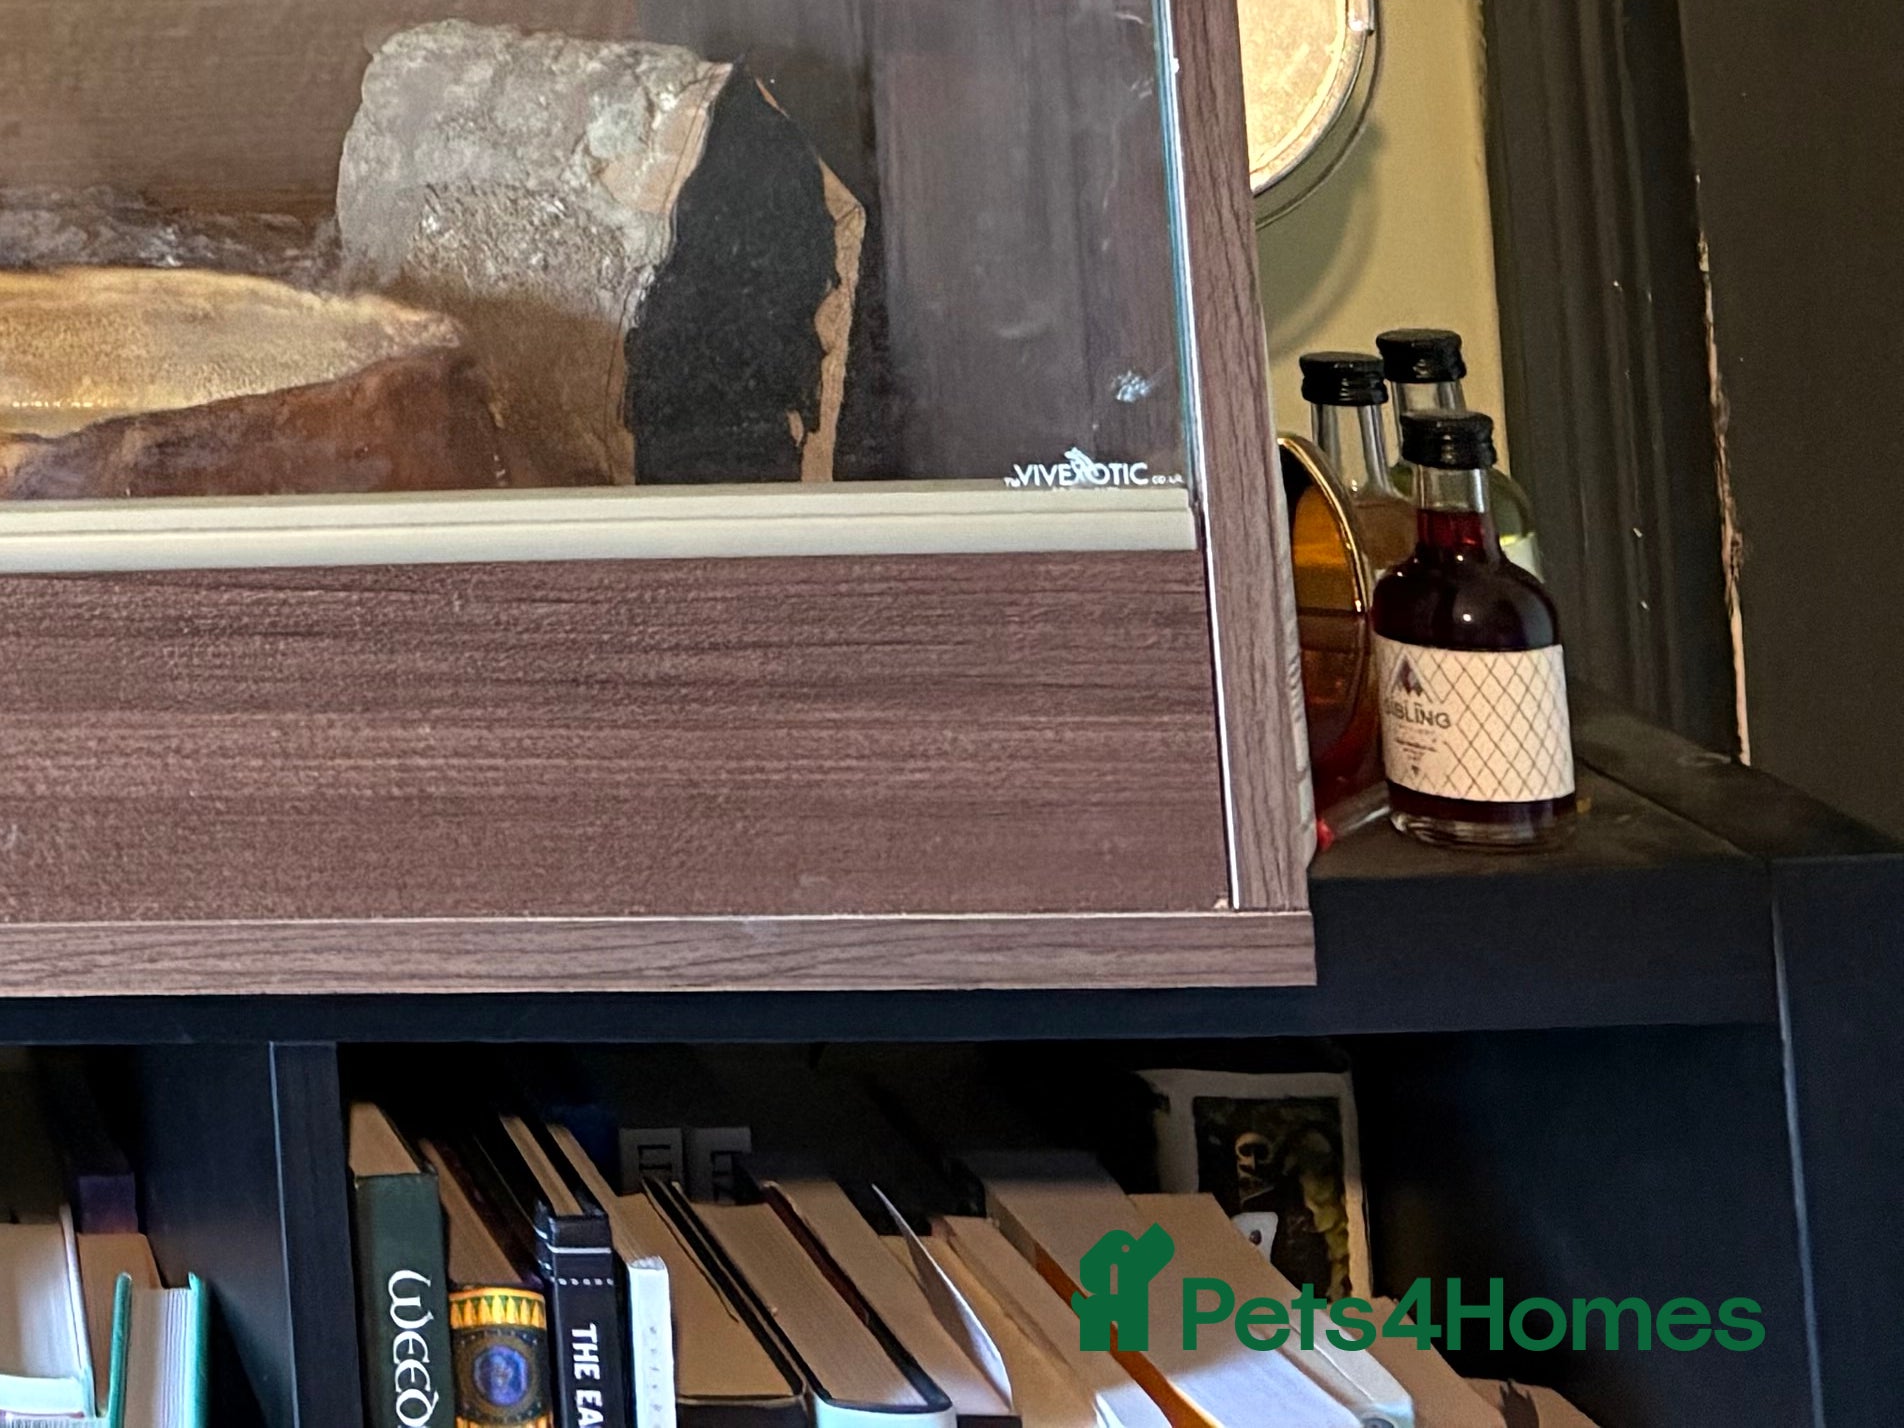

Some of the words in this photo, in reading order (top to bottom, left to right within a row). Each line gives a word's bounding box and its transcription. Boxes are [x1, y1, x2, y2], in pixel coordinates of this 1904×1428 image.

[388, 1269, 439, 1428] WEED
[570, 1322, 601, 1382] THE
[575, 1389, 605, 1428] EA
